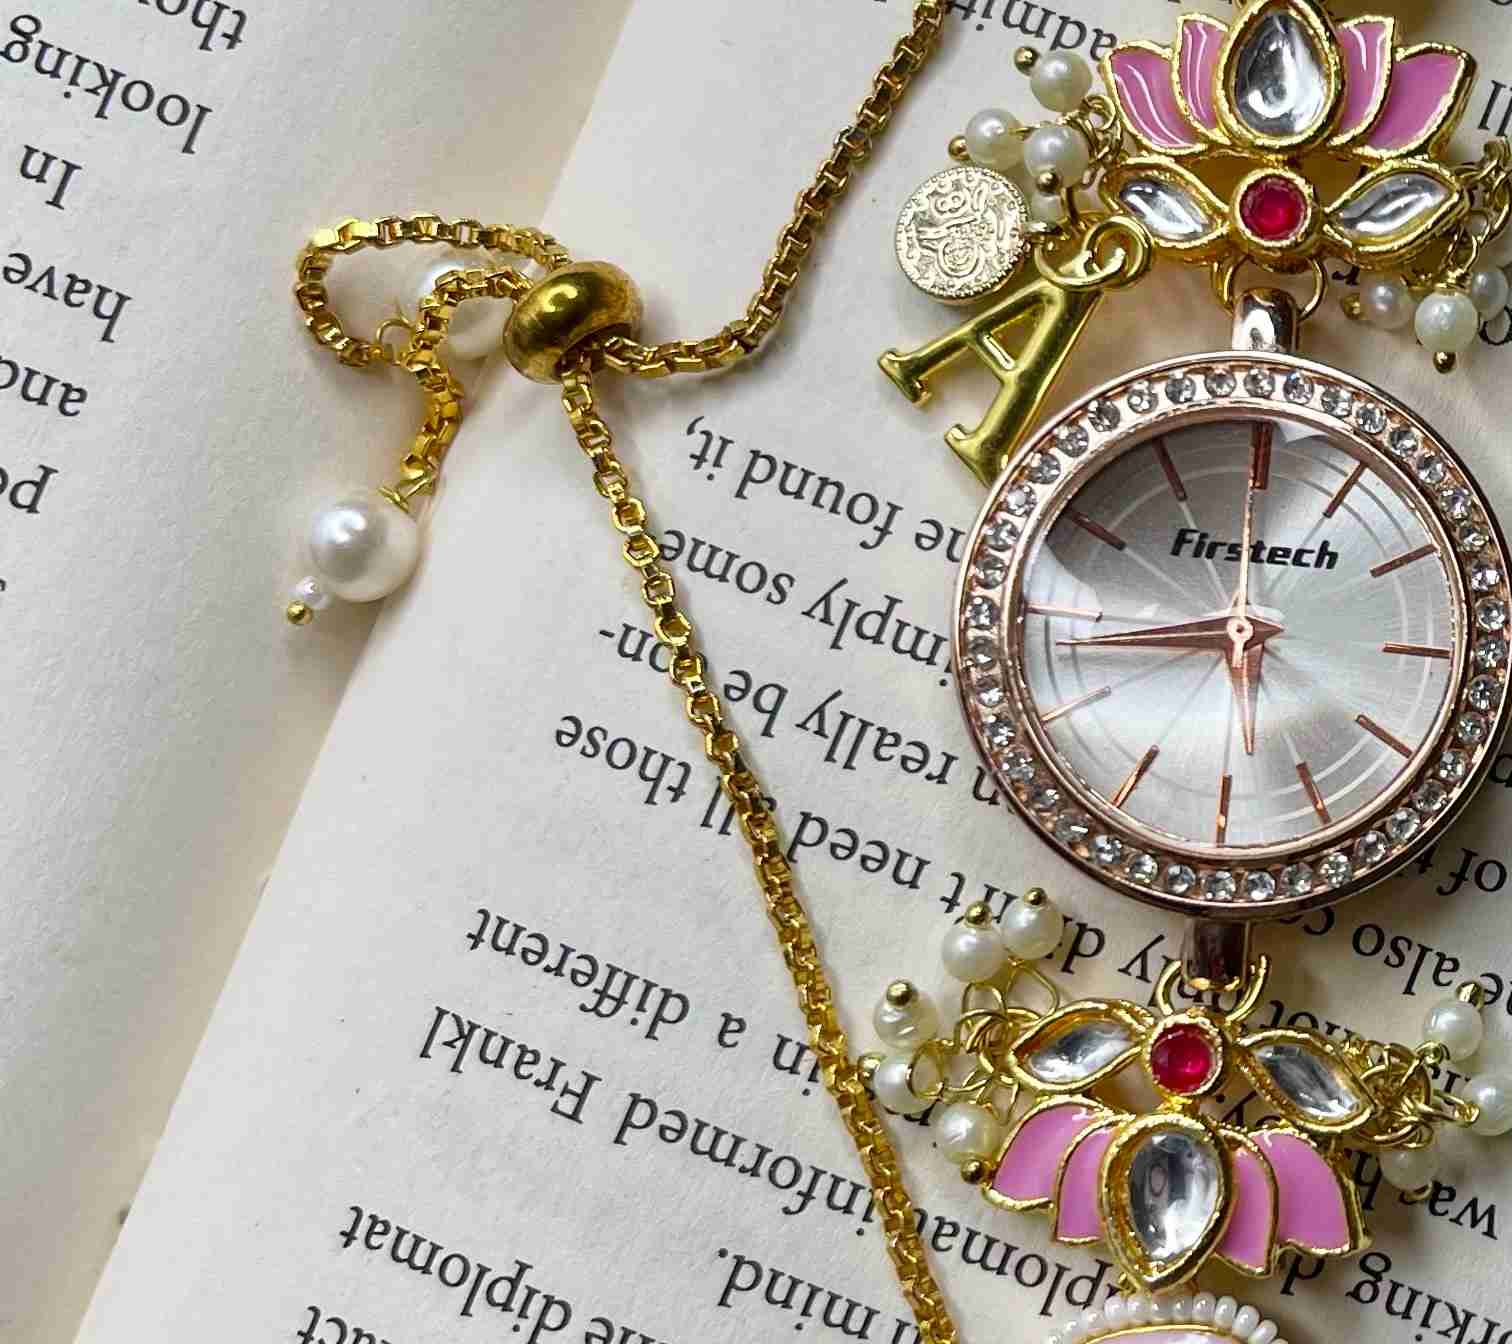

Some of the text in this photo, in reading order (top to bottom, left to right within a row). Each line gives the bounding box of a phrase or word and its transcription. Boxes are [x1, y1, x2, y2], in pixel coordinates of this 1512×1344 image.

[0, 13, 213, 155] looking
[18, 143, 83, 210] In
[1, 251, 132, 344] have
[659, 528, 795, 605] some
[1170, 528, 1339, 570] Firstech
[554, 714, 692, 806] those
[782, 810, 931, 890] need
[1432, 841, 1507, 900] of
[418, 1004, 603, 1125] Frankl
[611, 1091, 867, 1237] informed
[716, 1246, 881, 1341] mind.
